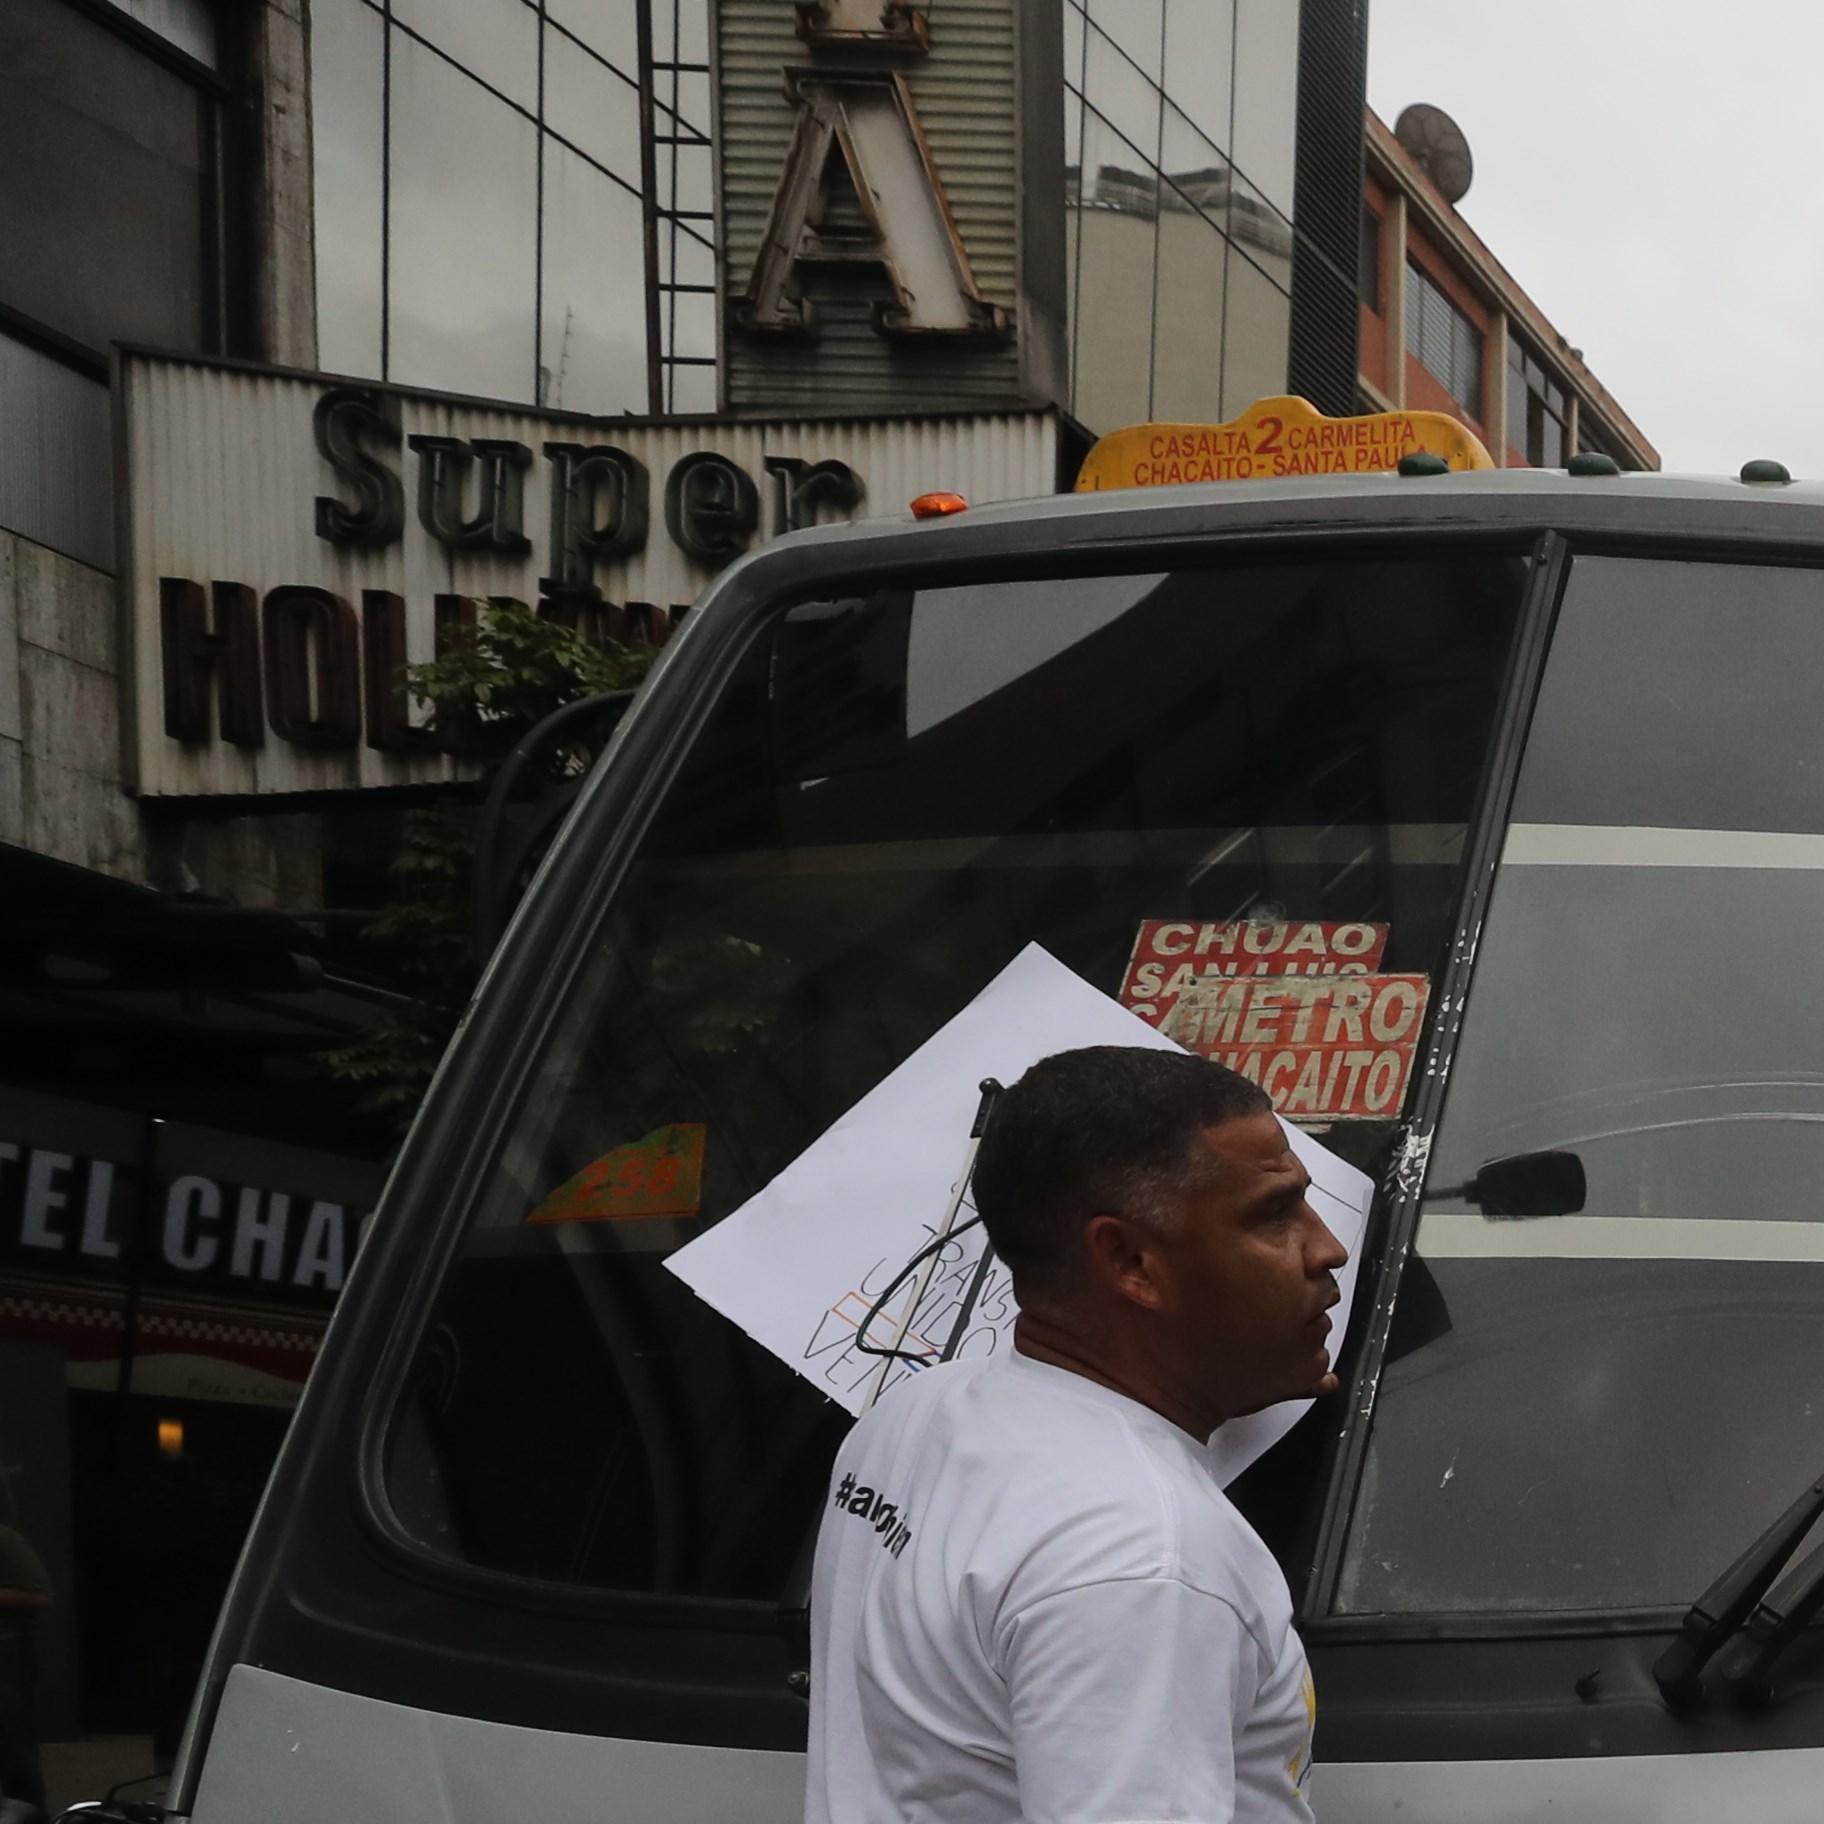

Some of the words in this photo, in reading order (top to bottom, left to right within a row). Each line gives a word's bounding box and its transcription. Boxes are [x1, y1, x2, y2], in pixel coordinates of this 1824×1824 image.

[1135, 456, 1252, 486] CHACAITO
[1273, 448, 1347, 477] SANTA
[1354, 443, 1427, 471] PAU
[1150, 431, 1250, 459] CASALTA
[1255, 416, 1284, 455] 2
[1287, 420, 1416, 450] CARMELITA
[314, 388, 867, 600] Super
[1151, 922, 1377, 956] CHUAO
[1184, 980, 1418, 1044] METRO
[162, 1174, 374, 1292] CHA
[908, 1222, 1022, 1332] TRANS
